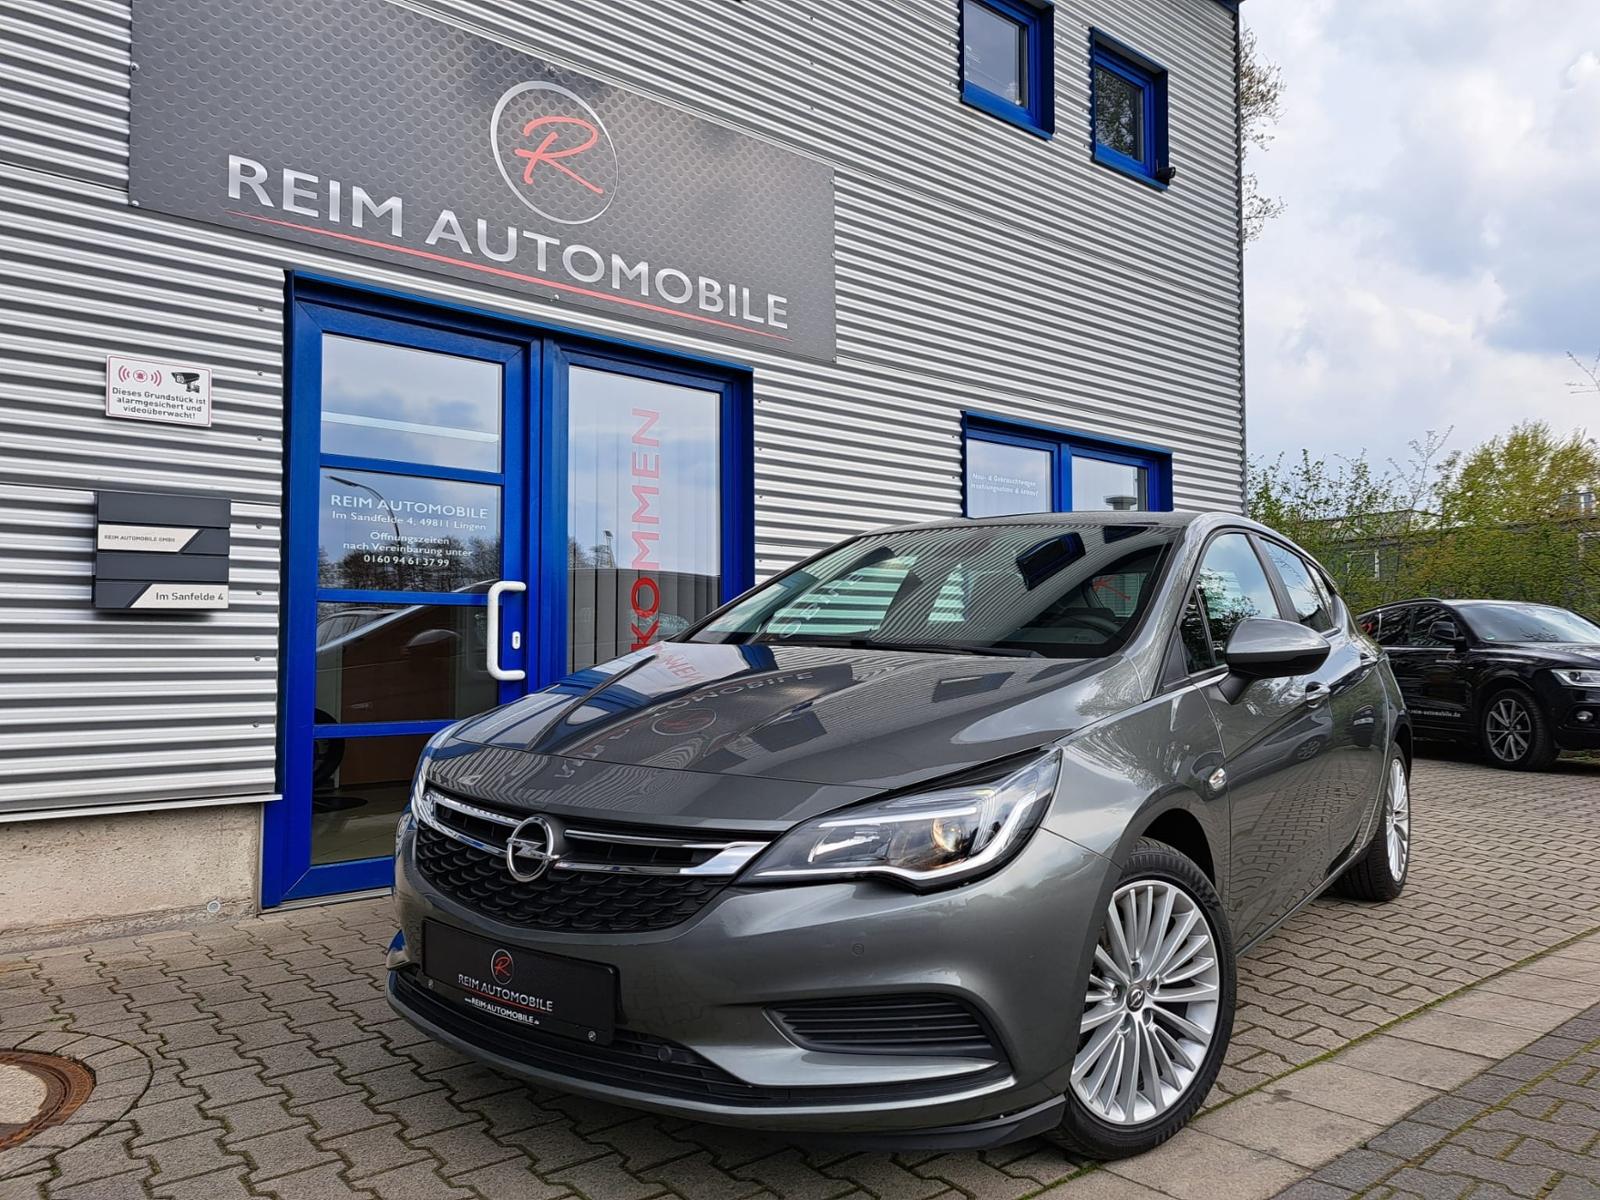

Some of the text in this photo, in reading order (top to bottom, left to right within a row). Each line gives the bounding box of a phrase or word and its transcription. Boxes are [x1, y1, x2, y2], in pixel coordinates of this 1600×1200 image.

[514, 115, 604, 194] R
[226, 154, 790, 330] REIM AUTOMOBILE
[112, 387, 206, 405] Dieses Grundstück ist
[117, 397, 184, 410] alarmgesichert
[123, 405, 196, 419] videoüberwacht!
[331, 495, 489, 519] REIM AUTOMOBILE
[332, 511, 347, 520] Im
[350, 511, 403, 524] Sandfelde
[419, 518, 449, 528] 49811
[453, 521, 487, 532] Lingen
[631, 408, 660, 652] KOMMEN
[370, 529, 450, 545] Öffnungszeiten
[343, 542, 473, 558] nach Vereinbarung unter
[363, 555, 450, 567] 0160 94 61 37 99
[155, 592, 224, 601] Im Sanfelde 4
[494, 956, 511, 976] R
[458, 974, 553, 1012] REIM AUTOMOBILE
